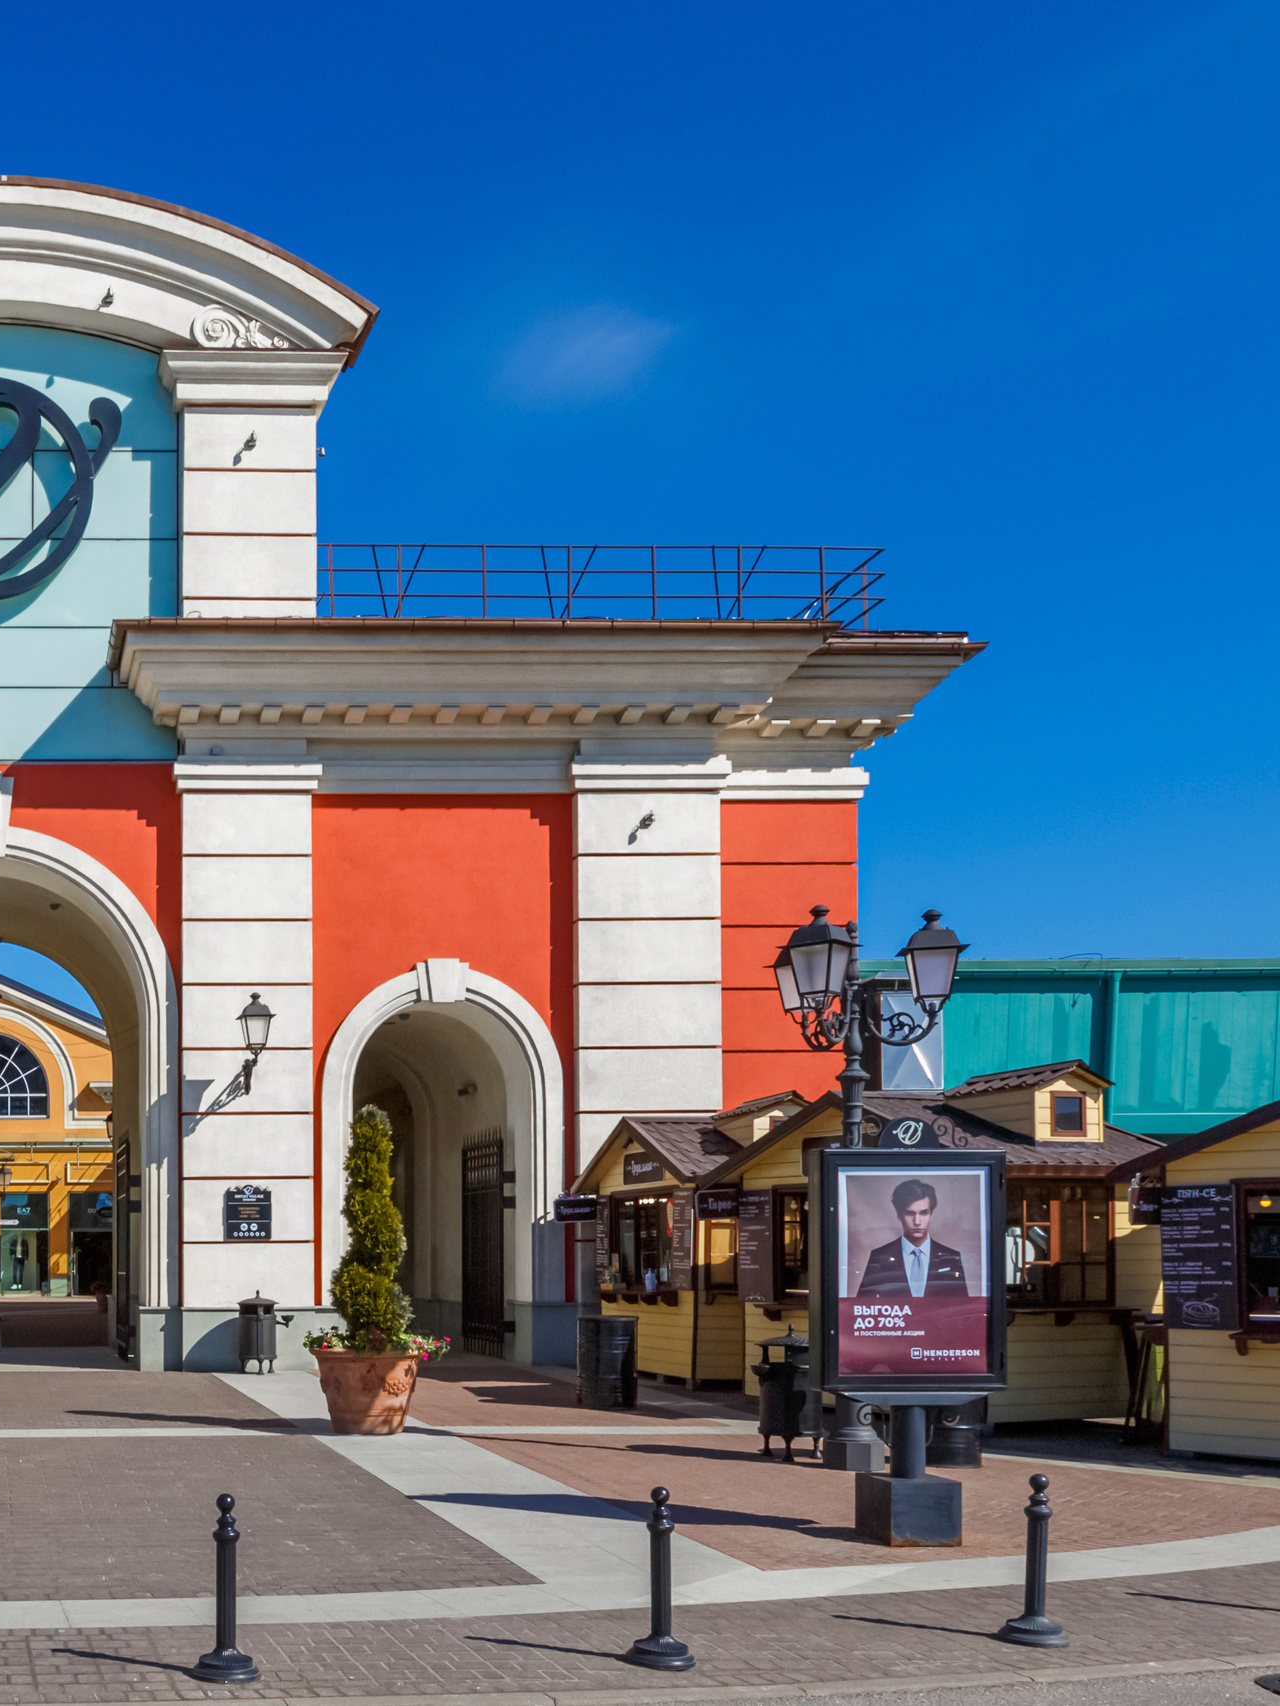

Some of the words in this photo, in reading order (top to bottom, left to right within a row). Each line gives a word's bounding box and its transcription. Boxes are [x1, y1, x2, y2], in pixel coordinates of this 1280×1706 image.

[853, 1305, 912, 1317] ВЫГОДА
[853, 1317, 875, 1330] ДО
[877, 1317, 906, 1328] 70%
[923, 1349, 981, 1357] HENDERSON
